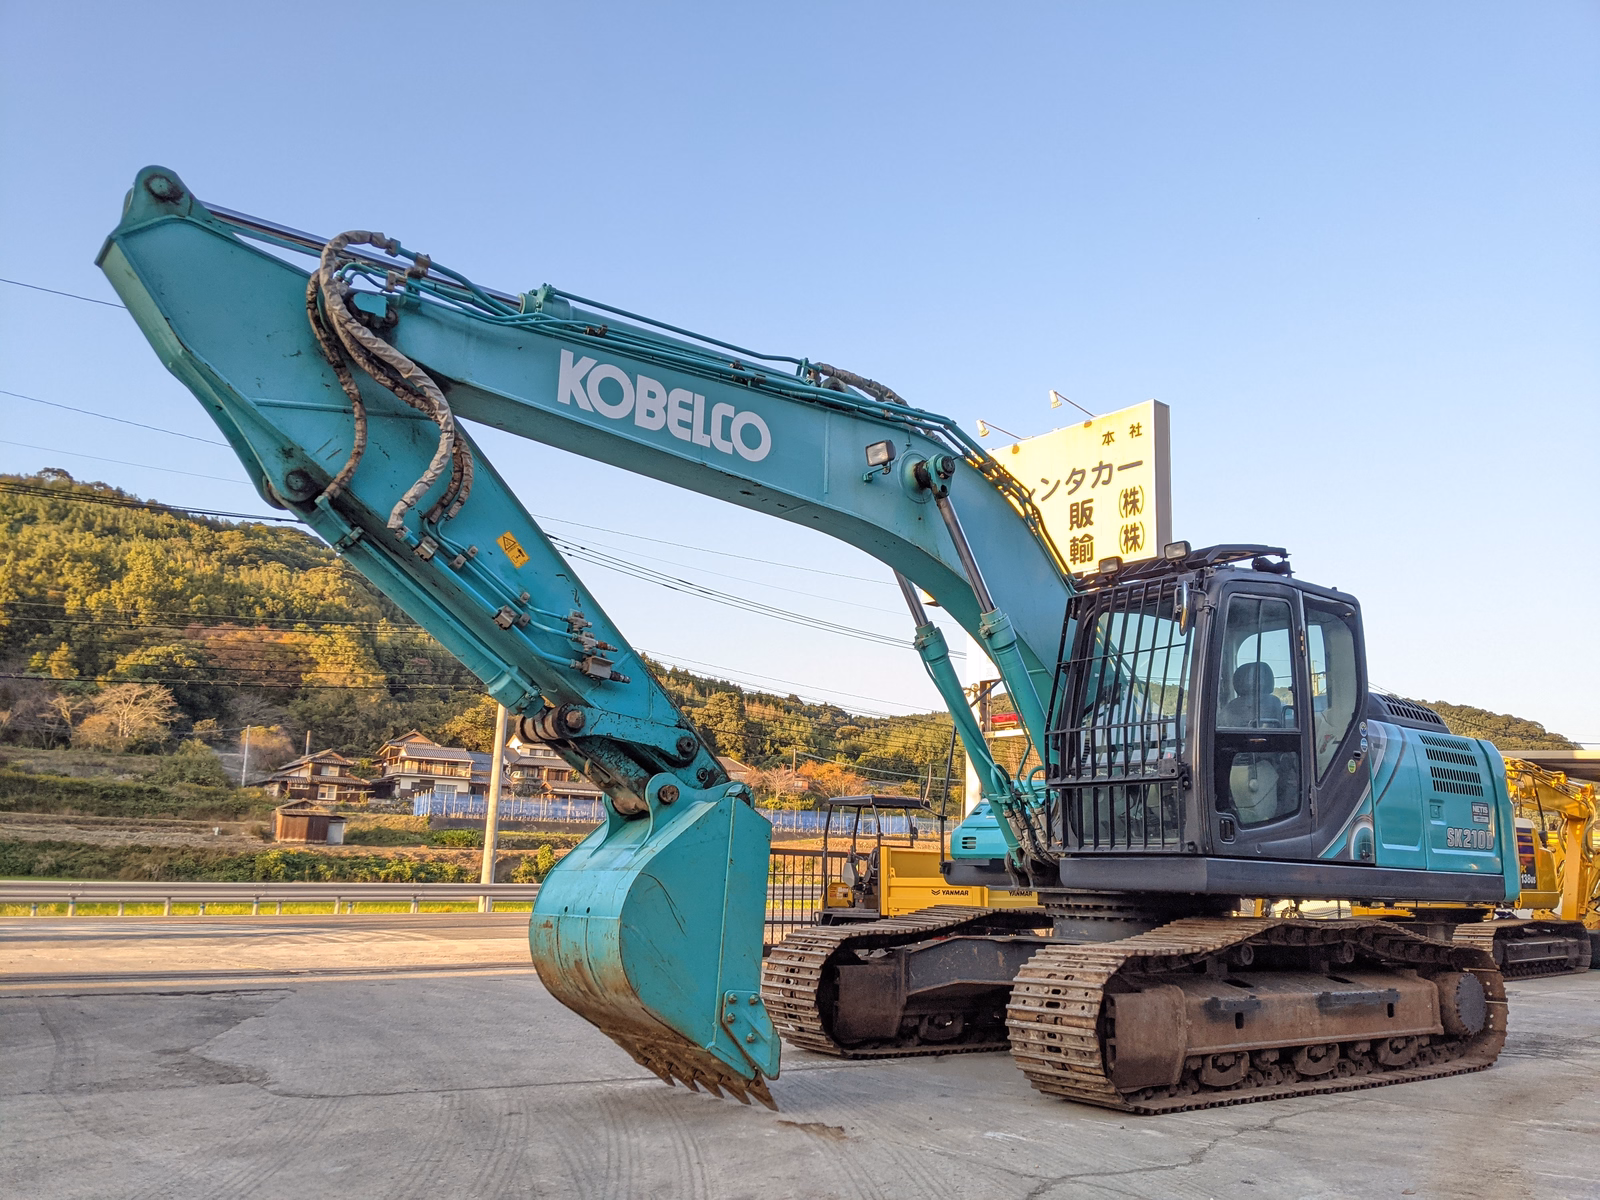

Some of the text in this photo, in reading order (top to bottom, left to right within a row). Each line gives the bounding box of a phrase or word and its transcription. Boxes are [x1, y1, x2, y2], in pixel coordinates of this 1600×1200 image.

[557, 348, 772, 462] KOBELCO
[1069, 498, 1094, 531] 販
[1069, 533, 1094, 565] 輸
